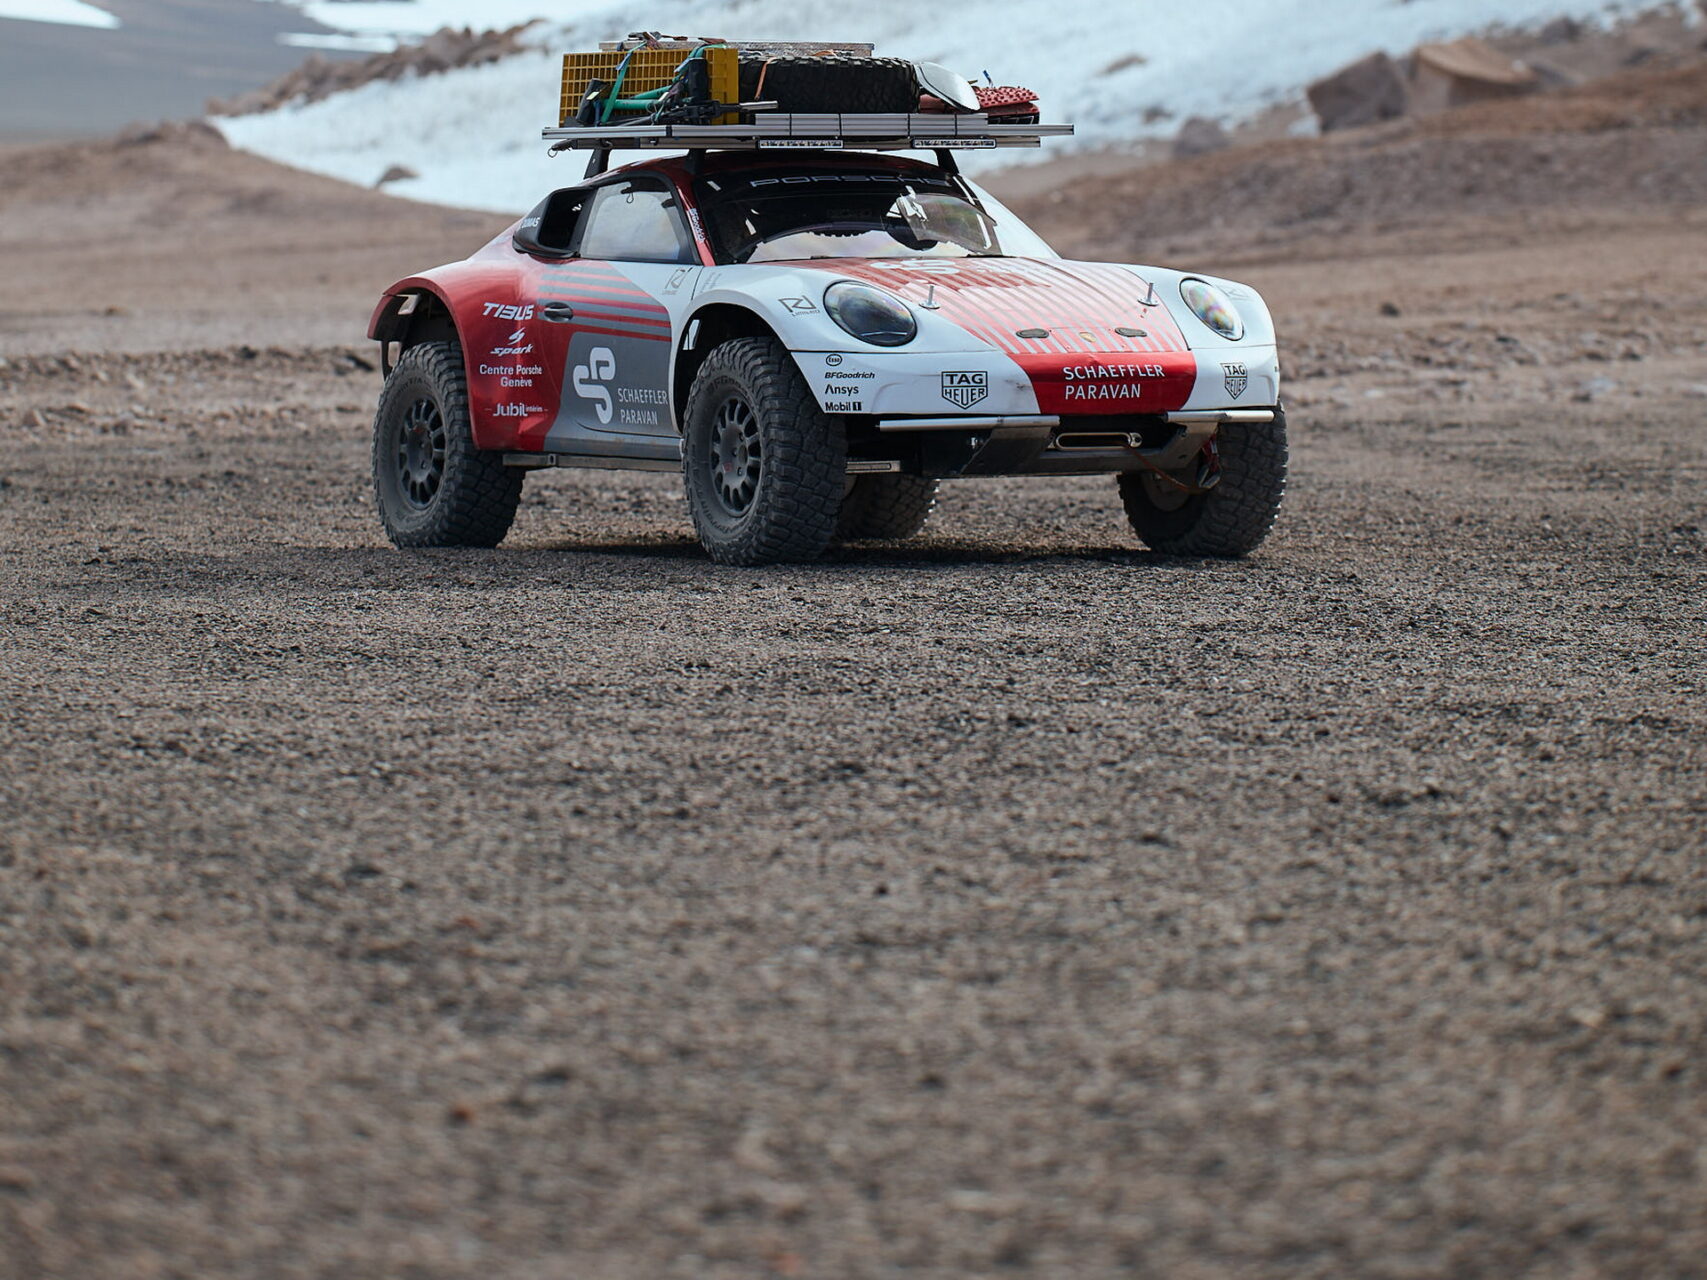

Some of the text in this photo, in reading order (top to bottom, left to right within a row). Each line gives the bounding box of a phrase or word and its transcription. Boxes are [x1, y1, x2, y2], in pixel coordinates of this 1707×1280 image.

[751, 175, 952, 188] PORSCHE
[490, 343, 534, 357] spark
[479, 364, 542, 375] Centre Porsche
[825, 371, 876, 379] BFGoodrich
[1062, 364, 1166, 381] SCHAEFFLER
[1224, 365, 1246, 375] TAG
[500, 376, 533, 387] Genève
[948, 373, 984, 385] TAG
[617, 387, 669, 406] SCHAEFFLER
[825, 383, 859, 397] Ansys
[944, 387, 986, 407] HEUER
[1064, 383, 1142, 401] PARAVAN
[493, 402, 528, 417] Jubil
[825, 401, 851, 411] Mobil
[620, 408, 658, 425] PARAVAN
